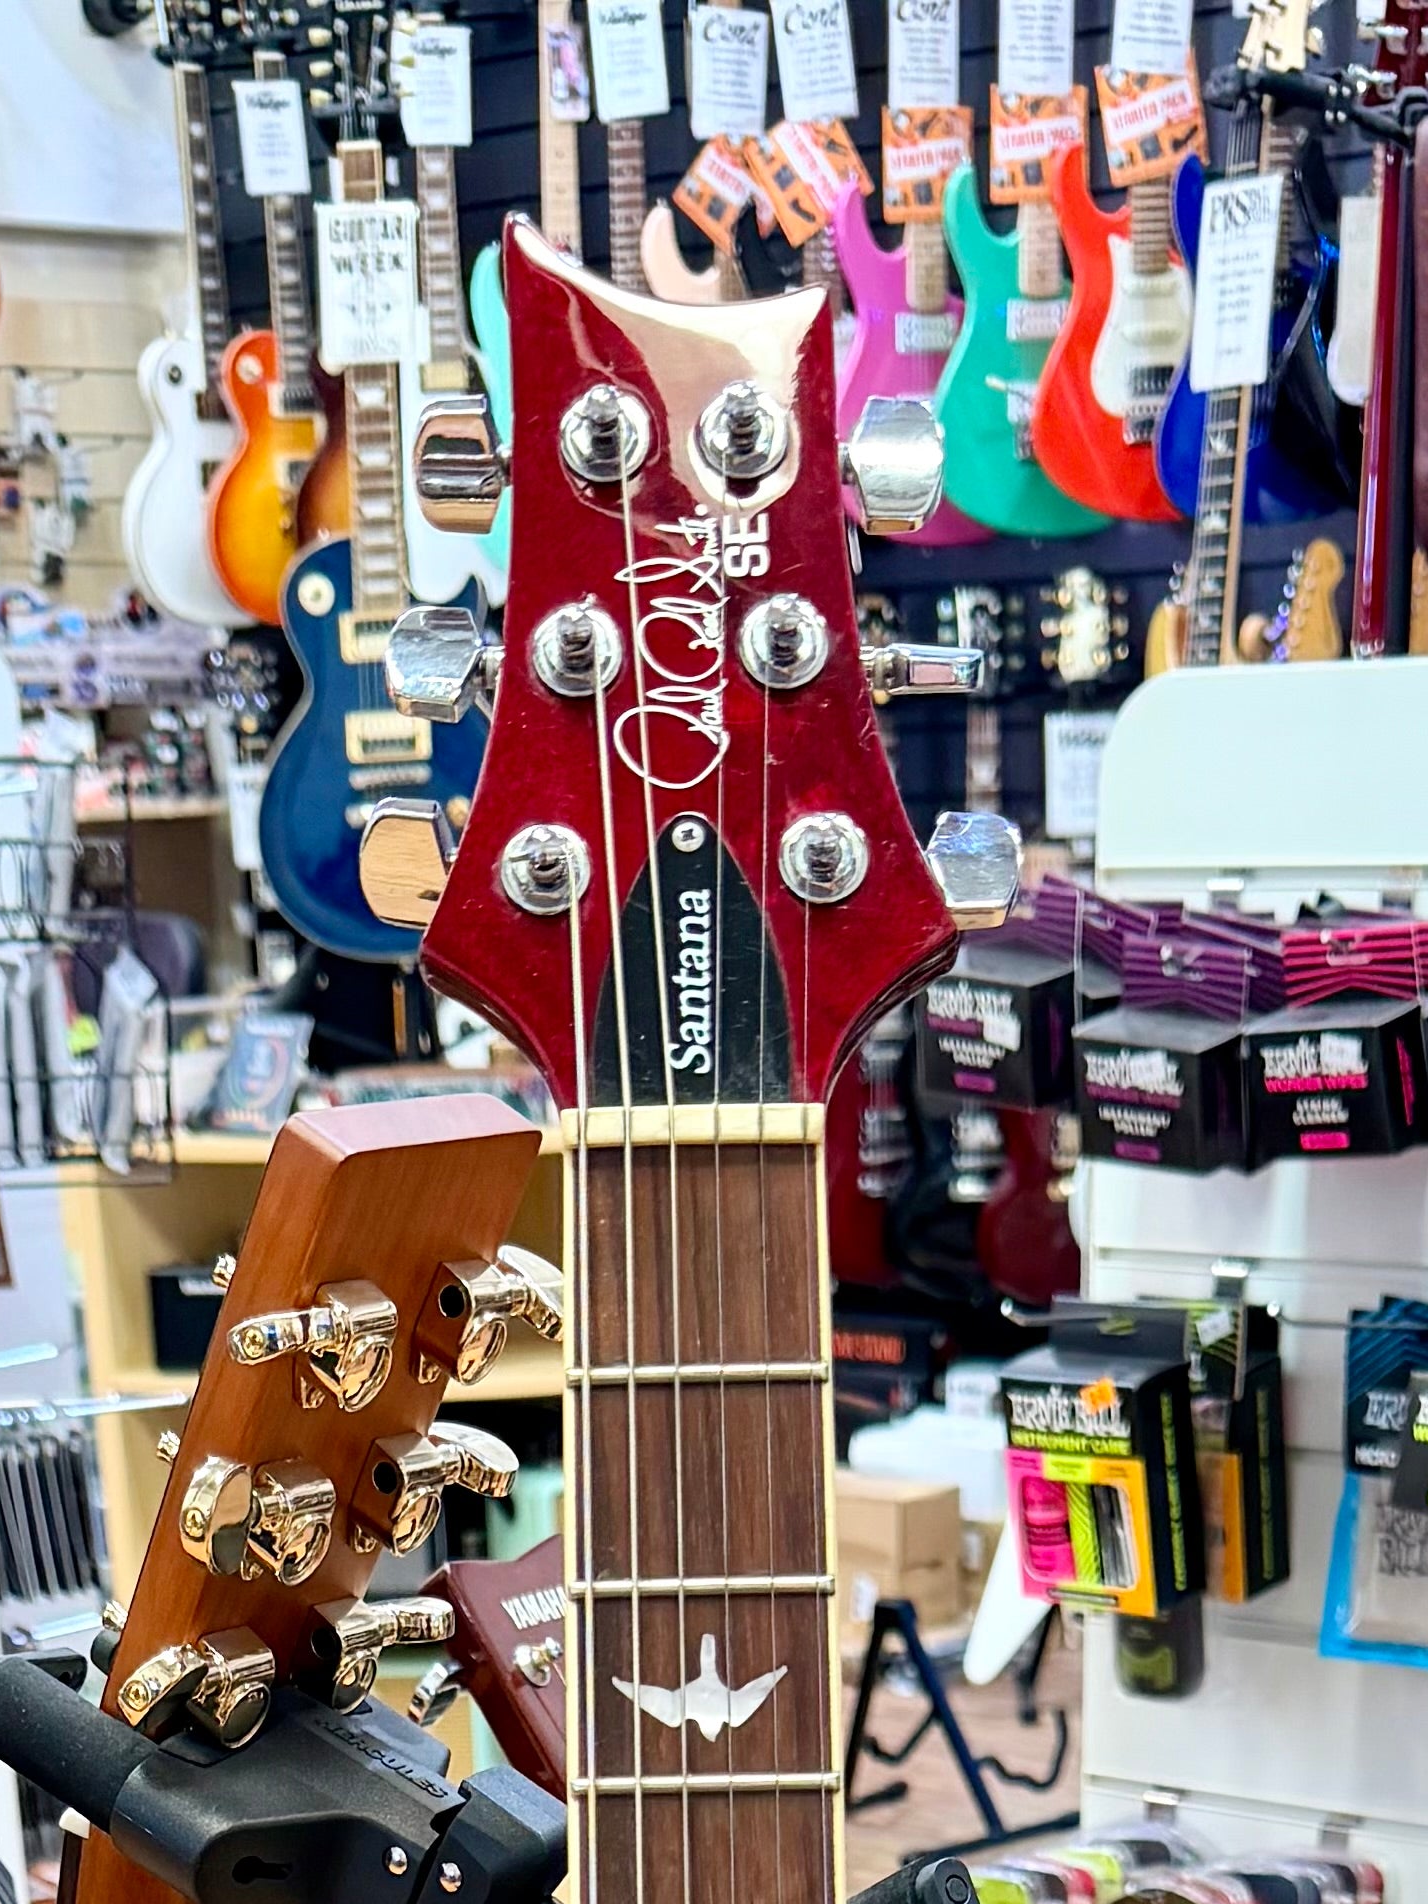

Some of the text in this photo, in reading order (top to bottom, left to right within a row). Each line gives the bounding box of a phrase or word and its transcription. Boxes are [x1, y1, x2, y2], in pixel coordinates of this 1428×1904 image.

[723, 512, 771, 579] SE
[668, 887, 713, 1074] Santana
[1006, 1384, 1069, 1431] ERNIE
[501, 1585, 566, 1631] YAMAH
